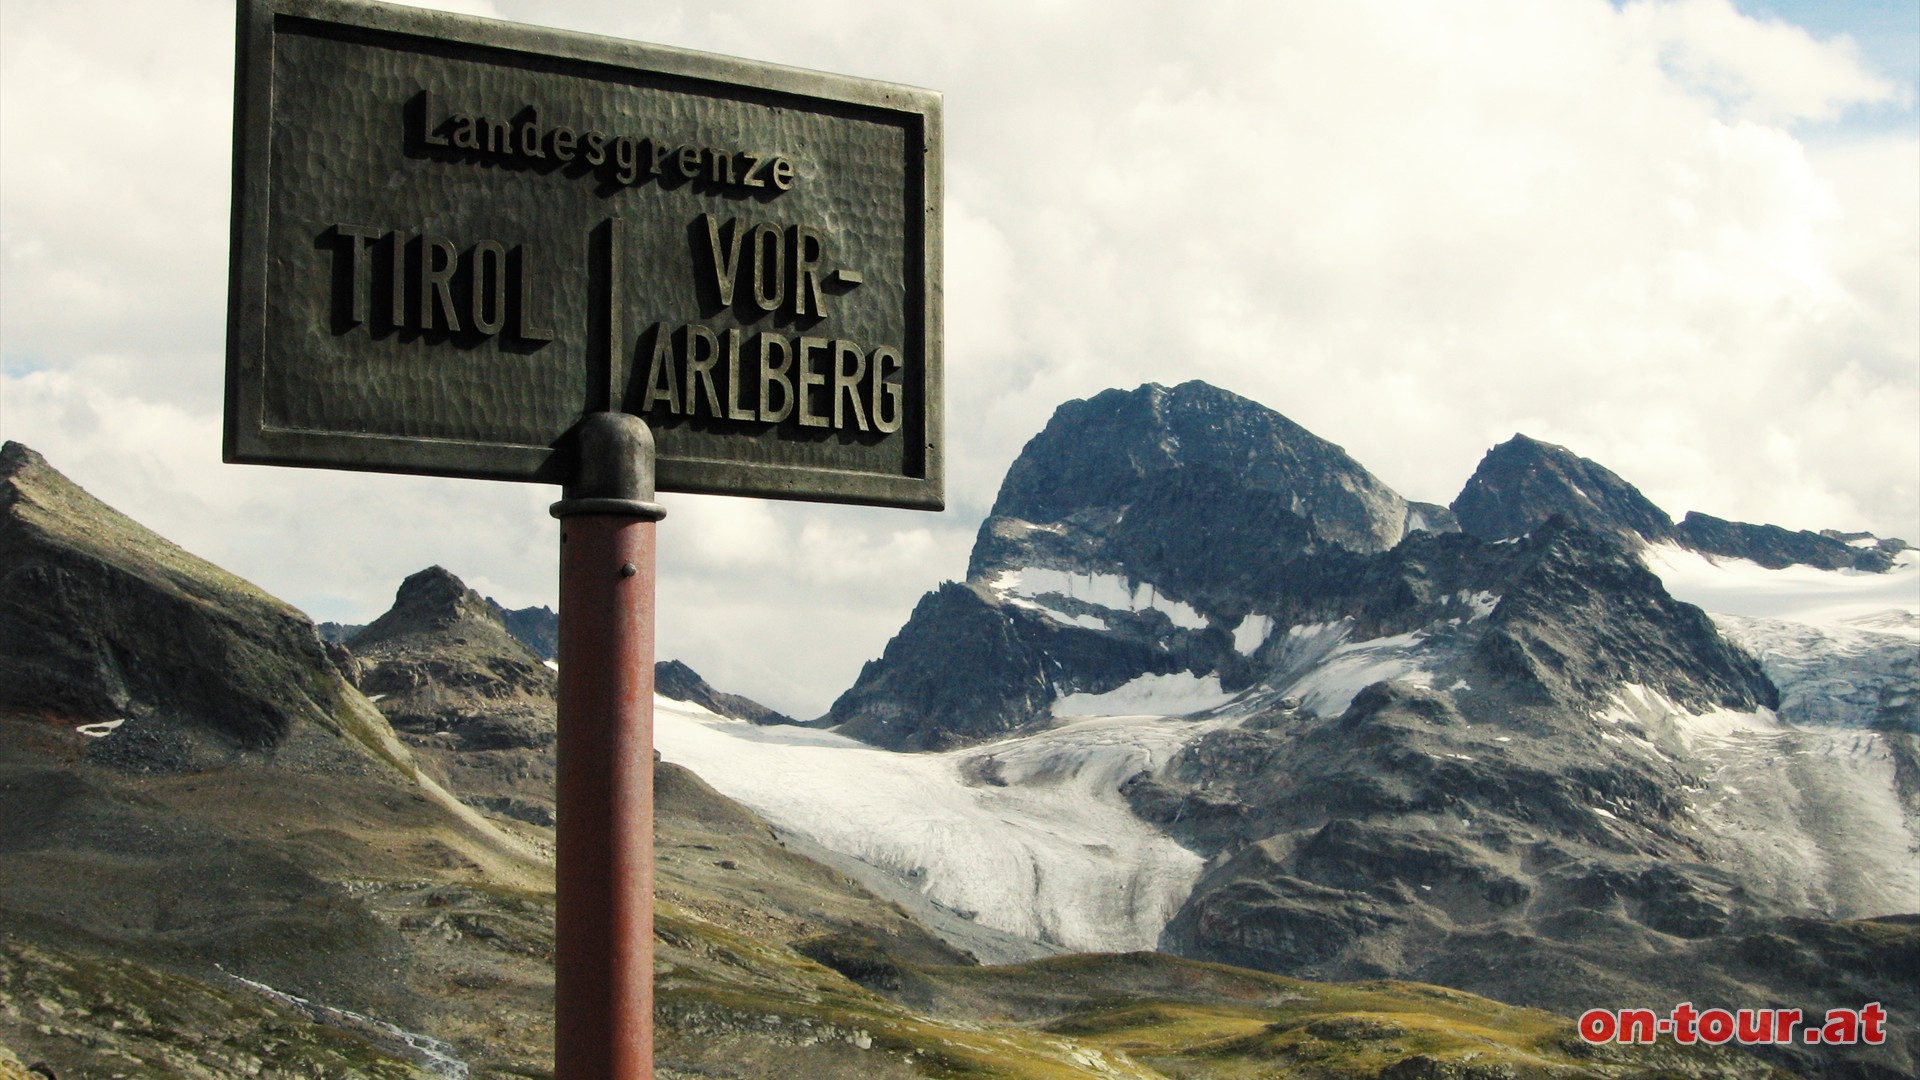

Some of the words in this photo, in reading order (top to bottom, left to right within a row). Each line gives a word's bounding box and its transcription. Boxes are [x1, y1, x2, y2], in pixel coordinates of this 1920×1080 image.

[424, 90, 796, 192] Landesgrenze
[336, 223, 554, 342] TIROL
[705, 212, 863, 319] VOR-
[642, 322, 903, 434] ARLBERG
